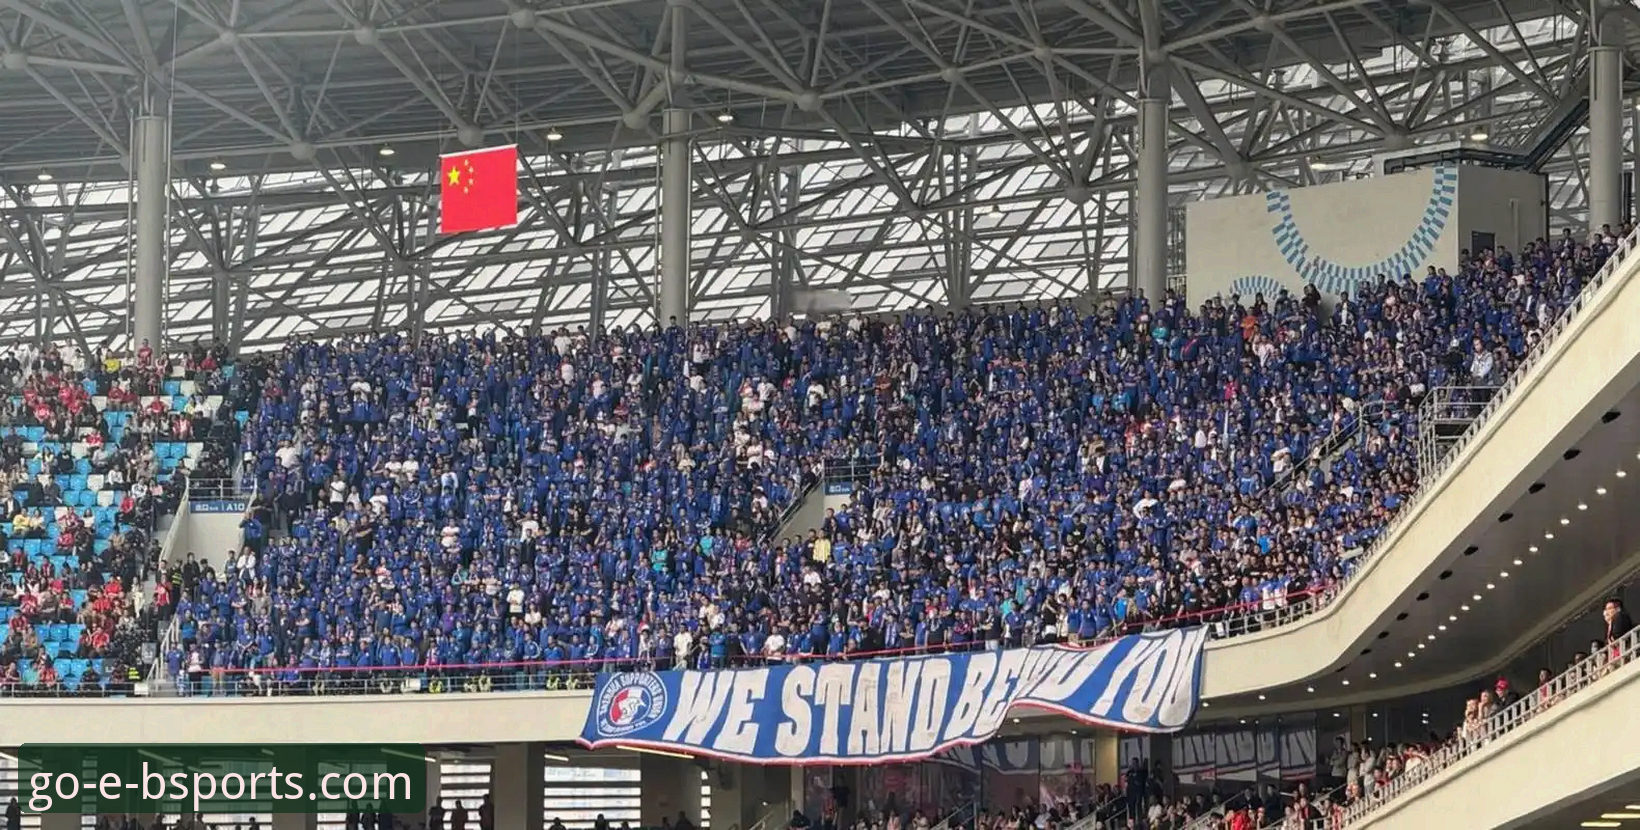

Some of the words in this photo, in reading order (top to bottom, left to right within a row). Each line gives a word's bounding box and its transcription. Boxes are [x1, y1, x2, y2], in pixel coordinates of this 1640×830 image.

[226, 502, 246, 511] A10
[662, 668, 770, 755] WE
[775, 657, 952, 757] STAND
[943, 635, 1123, 741] BED
[1090, 627, 1208, 727] YOU
